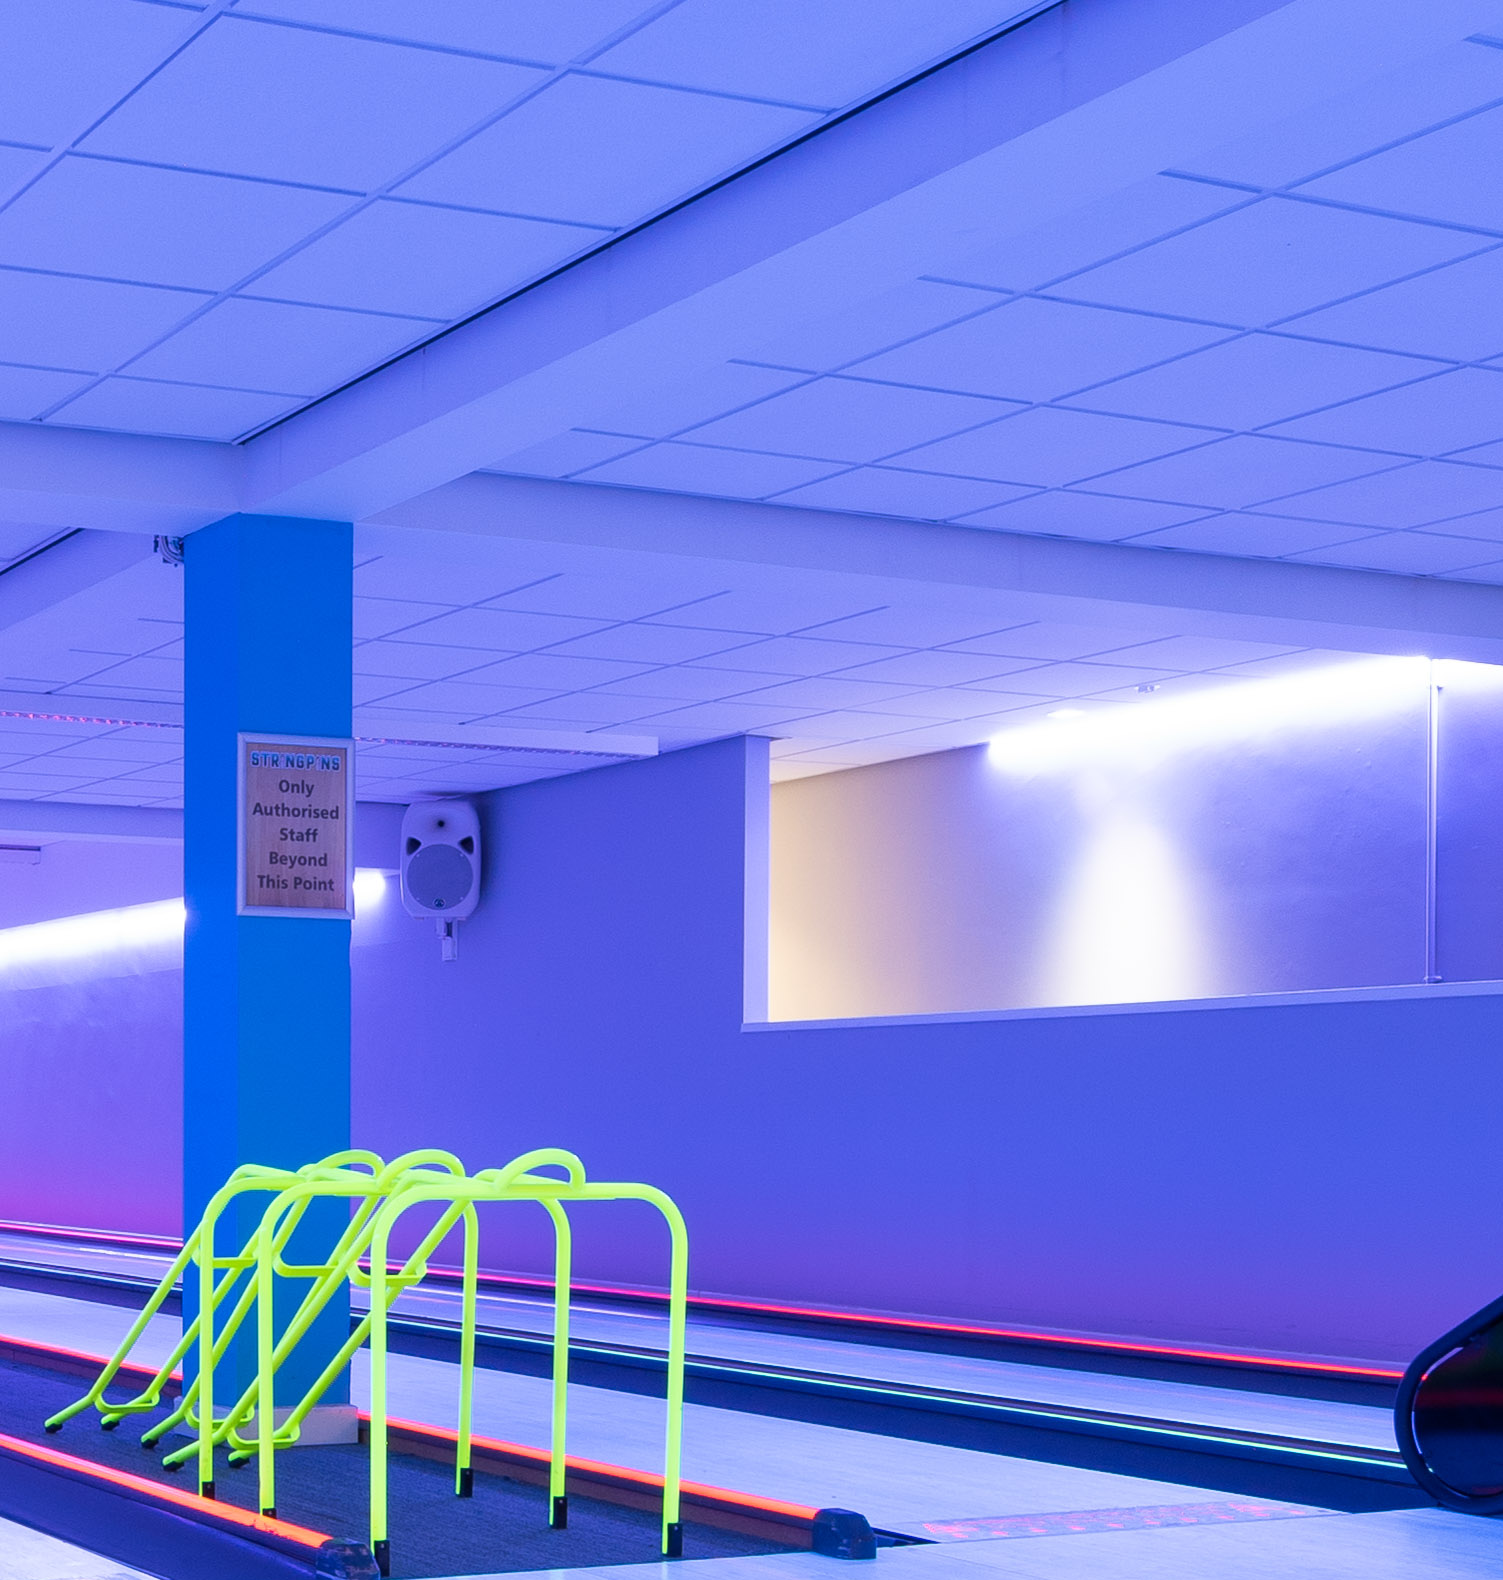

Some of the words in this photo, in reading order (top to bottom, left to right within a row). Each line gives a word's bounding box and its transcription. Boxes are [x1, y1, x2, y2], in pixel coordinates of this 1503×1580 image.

[278, 780, 314, 797] Only
[252, 803, 339, 820] Authorised
[279, 828, 318, 842] Staff
[269, 852, 327, 869] Beyond
[257, 875, 288, 889] This
[293, 877, 334, 891] Point
